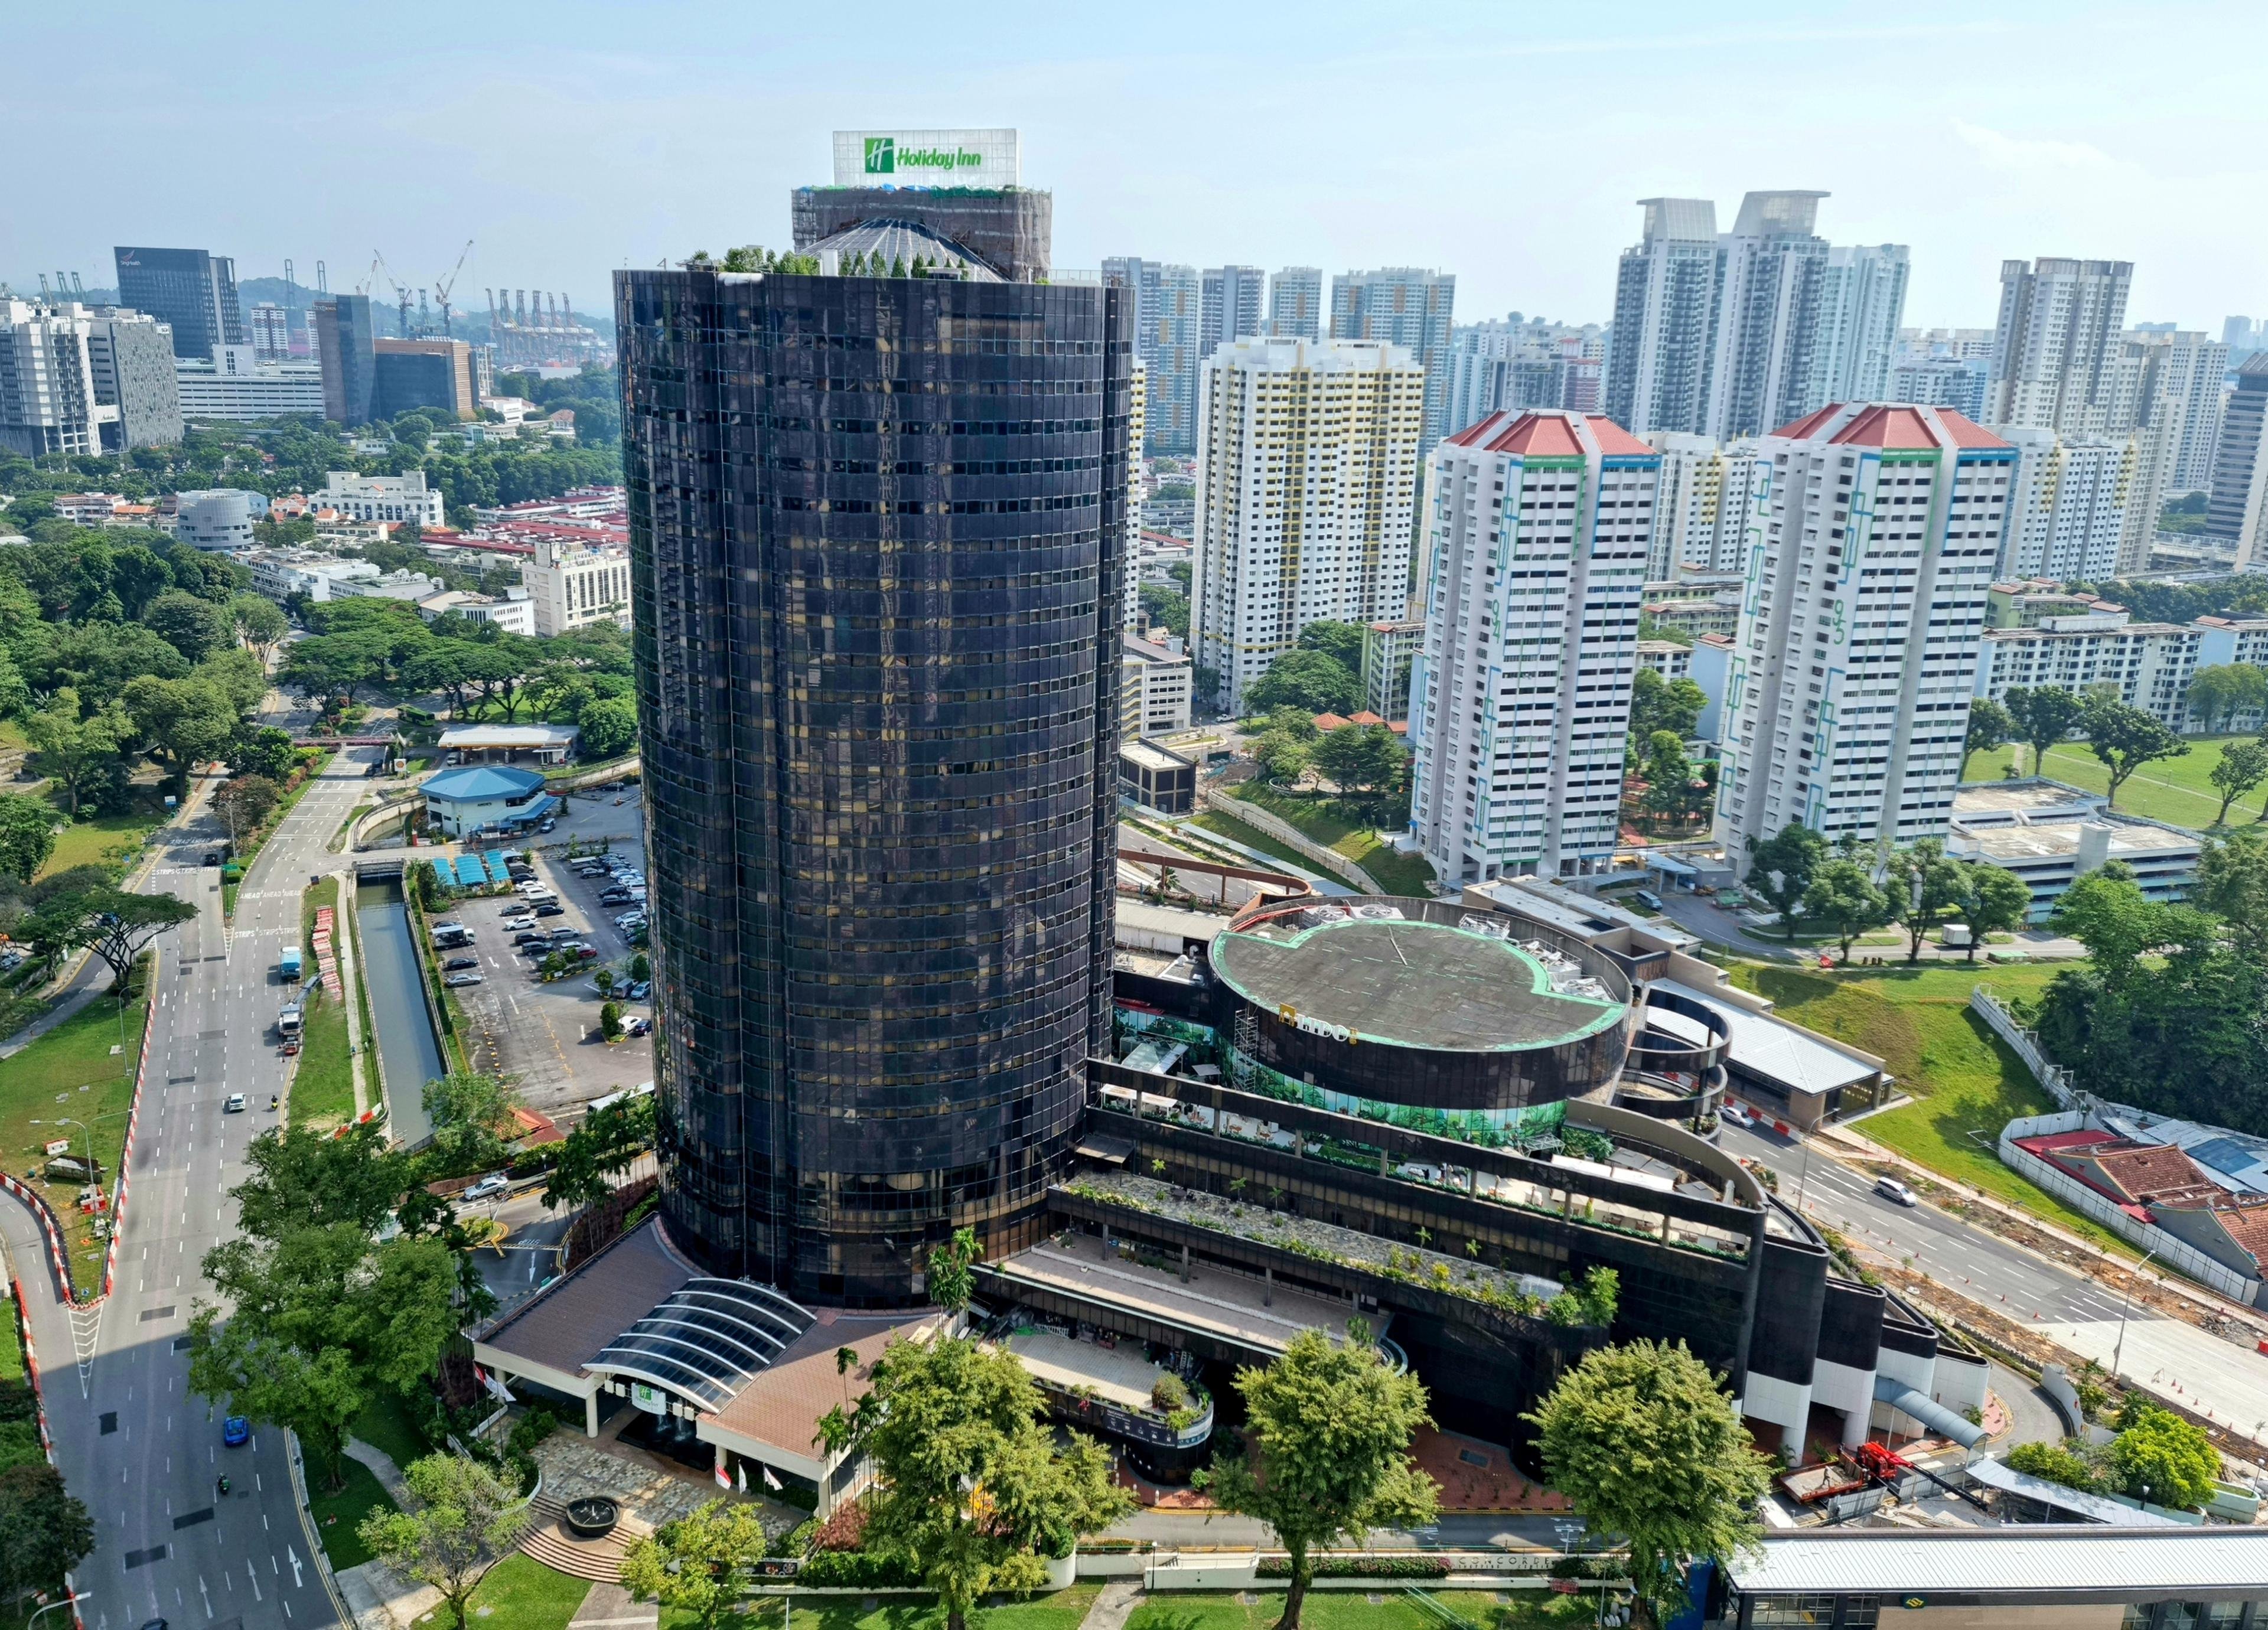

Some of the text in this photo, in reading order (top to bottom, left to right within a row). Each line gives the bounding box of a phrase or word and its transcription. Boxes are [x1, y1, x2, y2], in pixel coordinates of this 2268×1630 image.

[897, 146, 982, 169] Holiday Inn
[1491, 599, 1501, 644] 94
[1833, 599, 1847, 645] 95
